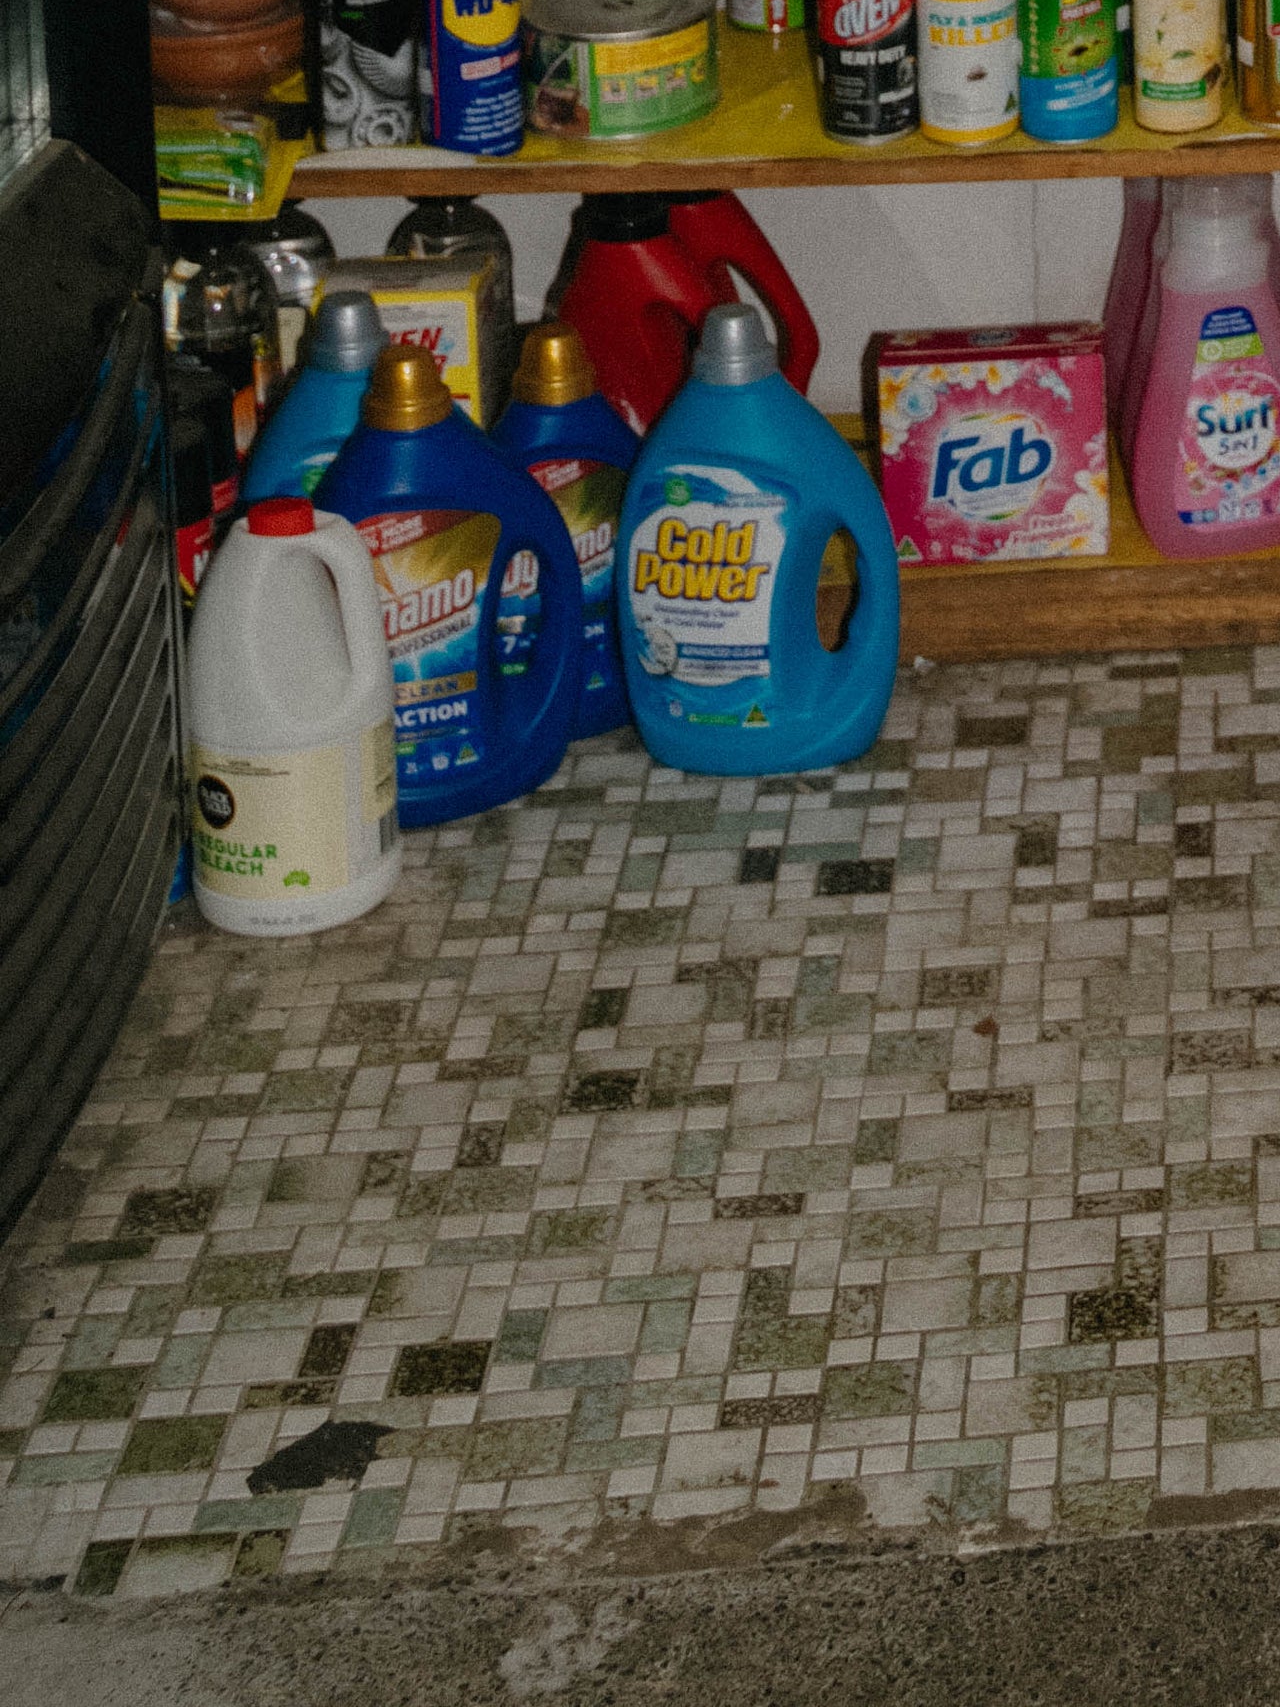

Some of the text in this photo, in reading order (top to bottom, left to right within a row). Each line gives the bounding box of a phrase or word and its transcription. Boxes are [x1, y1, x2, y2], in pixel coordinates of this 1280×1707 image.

[1197, 398, 1268, 438] Surf
[931, 428, 1053, 500] Fab
[656, 518, 758, 564] Cold
[633, 553, 772, 602] Power
[383, 567, 477, 643] namo
